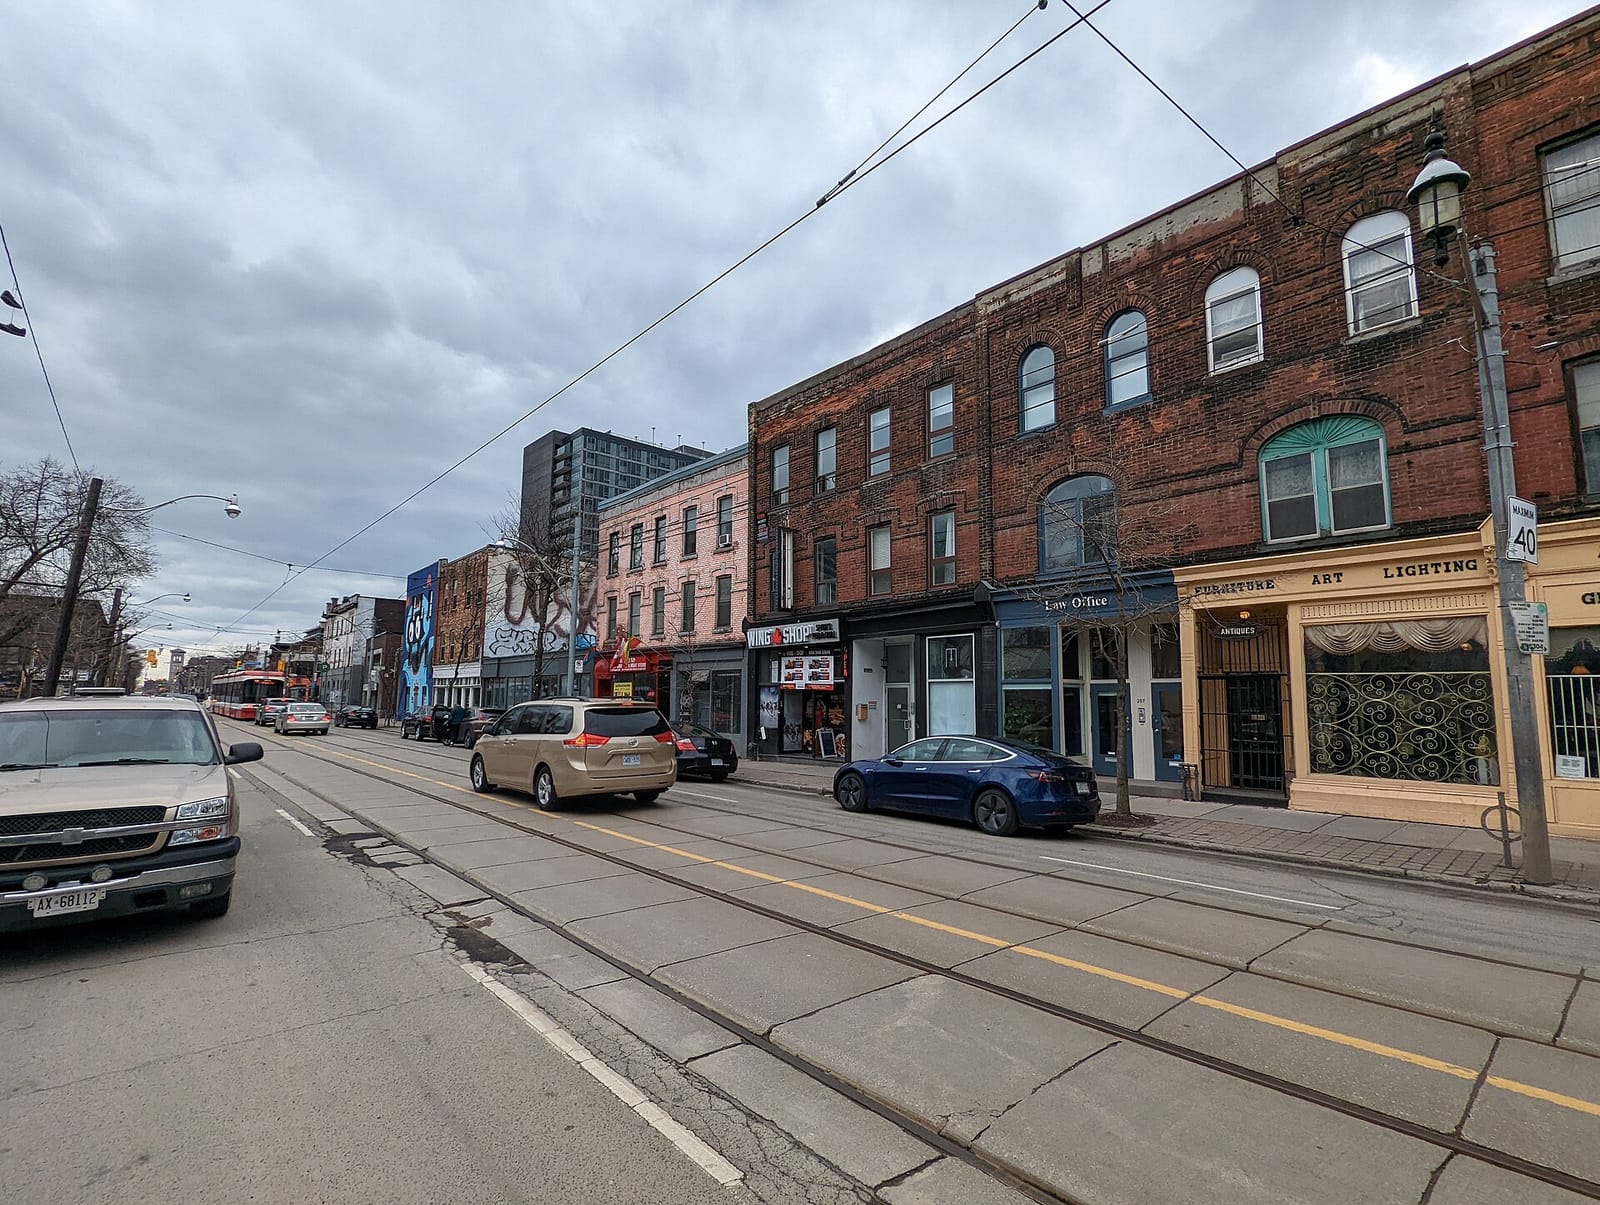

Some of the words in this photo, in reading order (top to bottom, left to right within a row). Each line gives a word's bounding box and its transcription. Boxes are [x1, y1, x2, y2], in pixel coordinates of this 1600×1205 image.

[1512, 505, 1534, 519] MAXIMUM
[1513, 526, 1536, 555] 40
[1194, 579, 1276, 595] FURNITURE
[1311, 572, 1344, 586] ART
[1383, 559, 1478, 579] LIGHTING
[1044, 600, 1067, 611] Law
[1071, 596, 1108, 608] Office
[747, 629, 772, 647] WING
[1220, 627, 1255, 635] ANTIQUES
